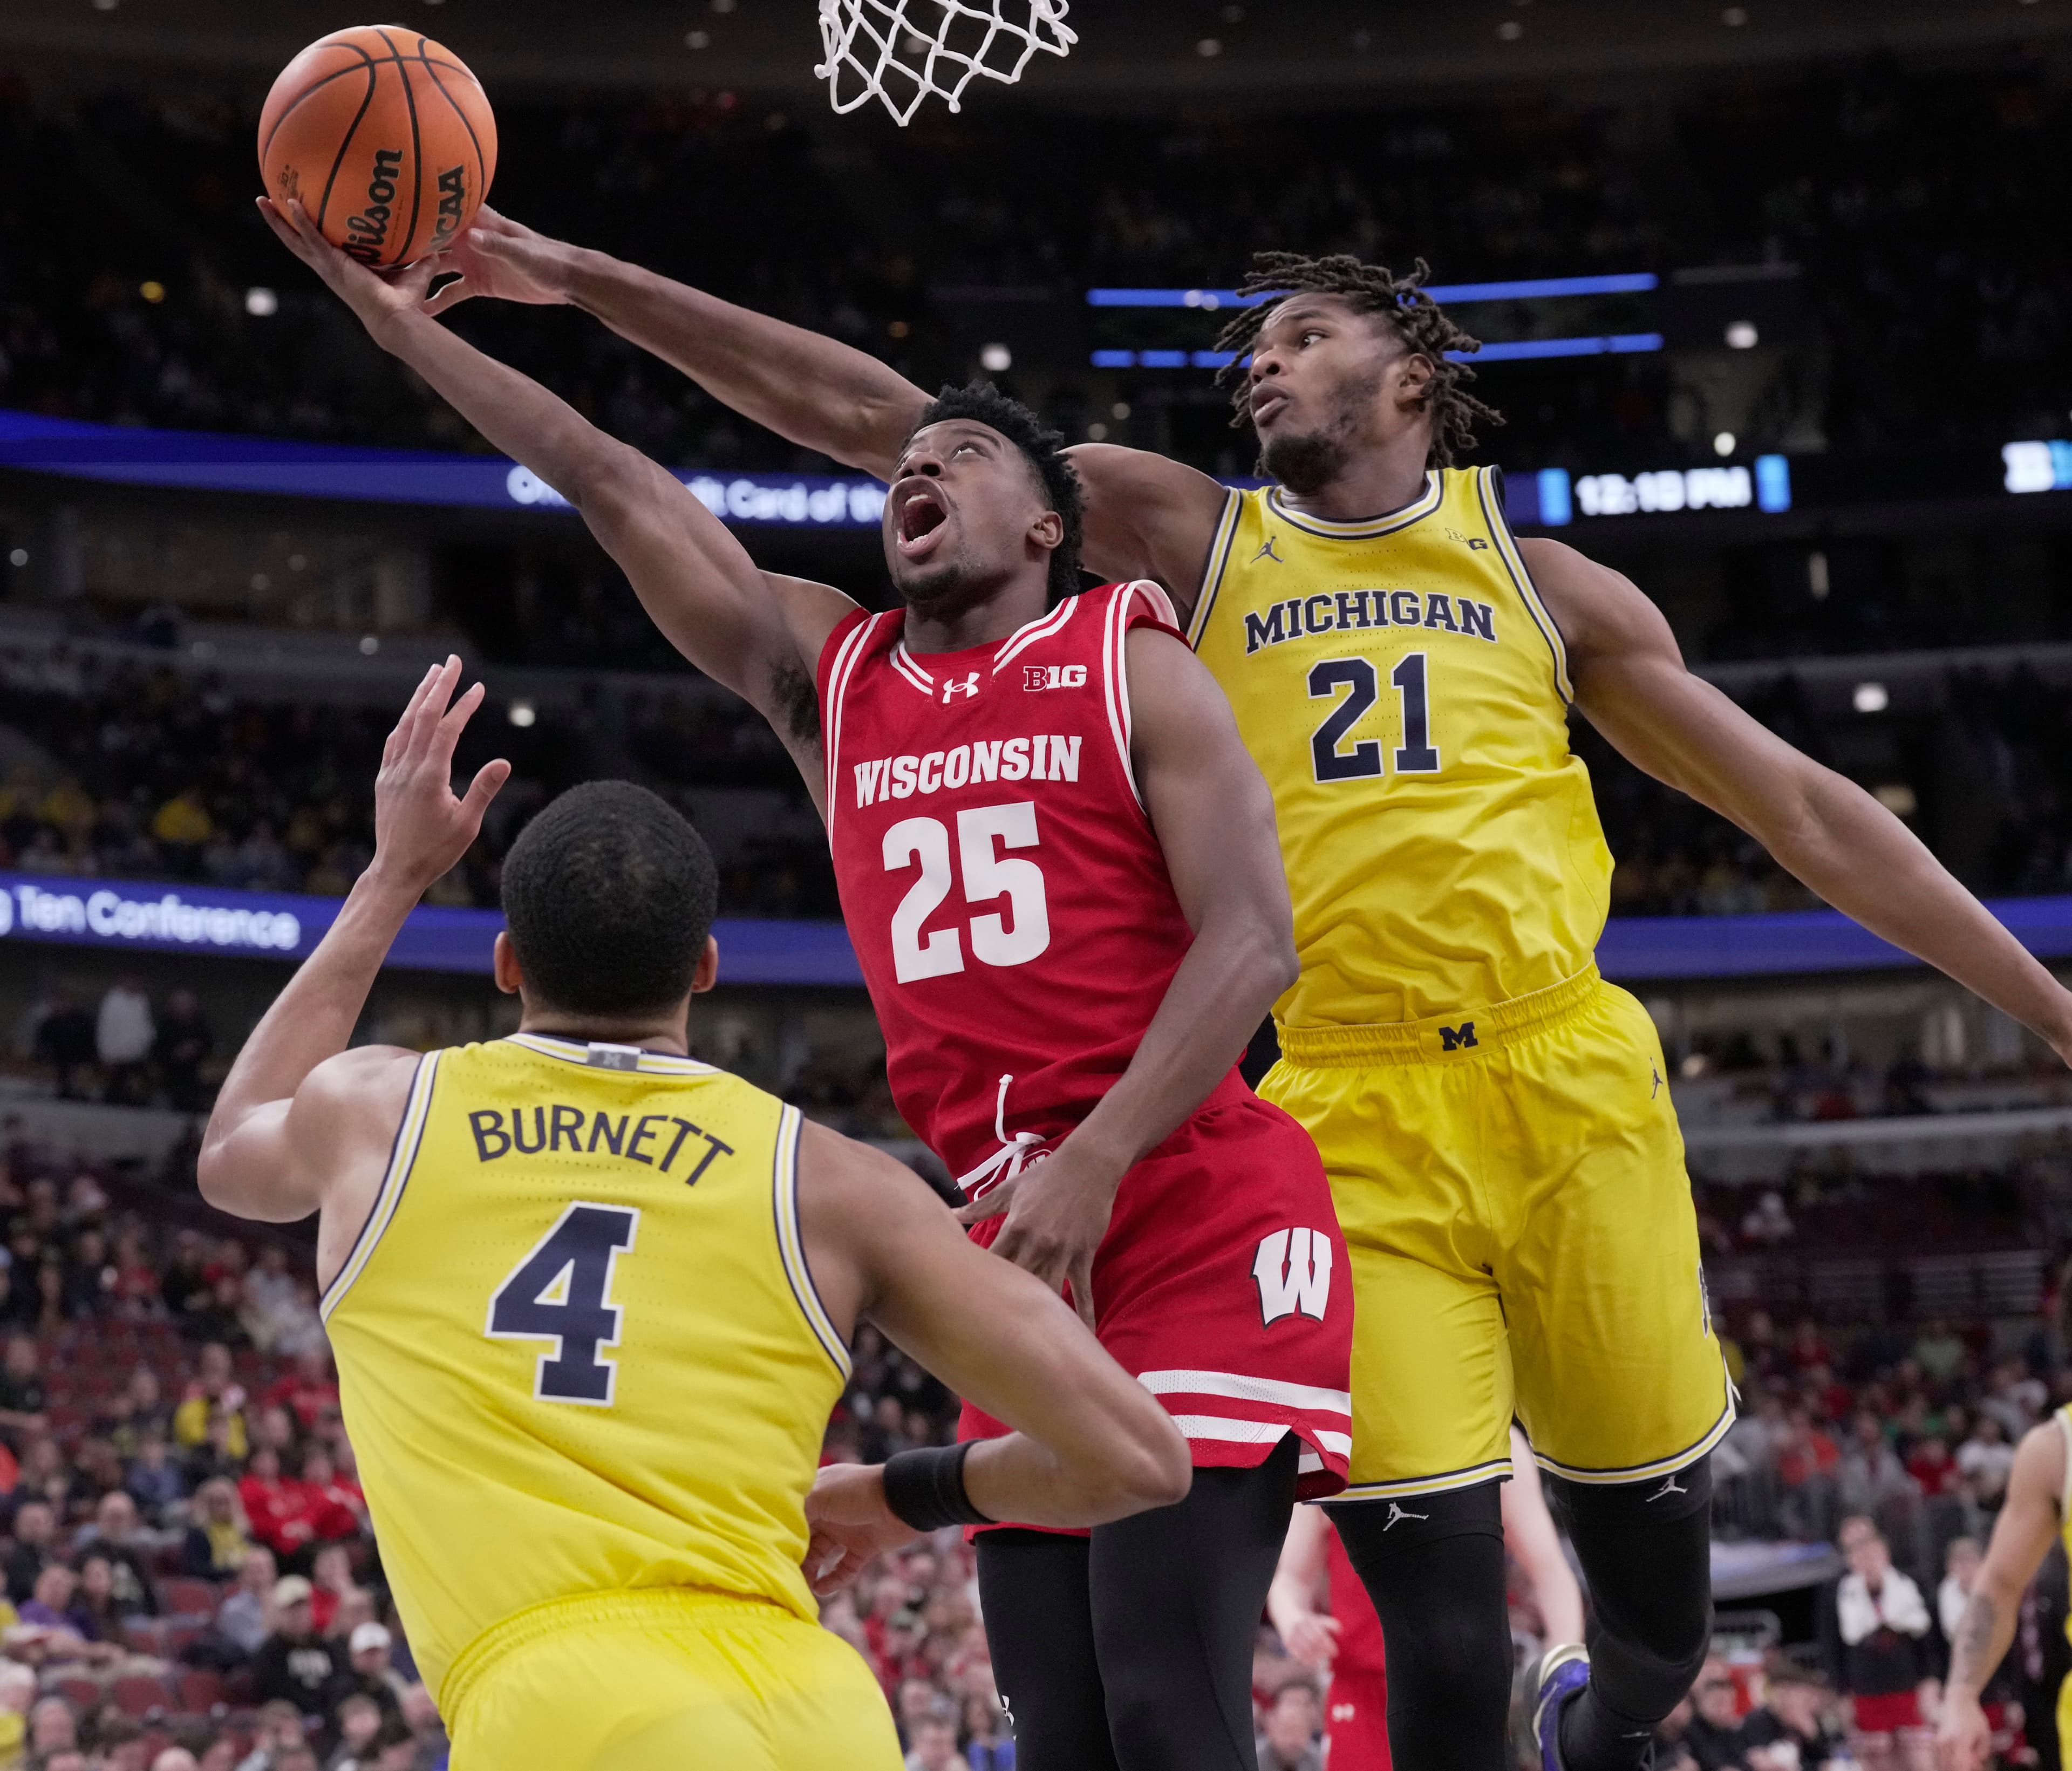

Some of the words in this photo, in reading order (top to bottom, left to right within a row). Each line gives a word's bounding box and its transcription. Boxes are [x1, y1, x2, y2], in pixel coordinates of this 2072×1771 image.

[726, 478, 808, 522] Card
[808, 482, 848, 523] of
[849, 482, 887, 523] th
[1445, 527, 1488, 550] BG
[1244, 589, 1498, 657] MICHIGAN
[1306, 651, 1441, 784] 21
[854, 734, 1082, 809] WISCONSIN
[13, 885, 86, 934] Ten
[86, 889, 301, 950] Conference
[882, 801, 1051, 984] 25
[1438, 1021, 1479, 1052] M
[468, 1104, 735, 1187] BURNETT
[484, 1199, 640, 1408] 4
[1250, 1227, 1333, 1330] W
